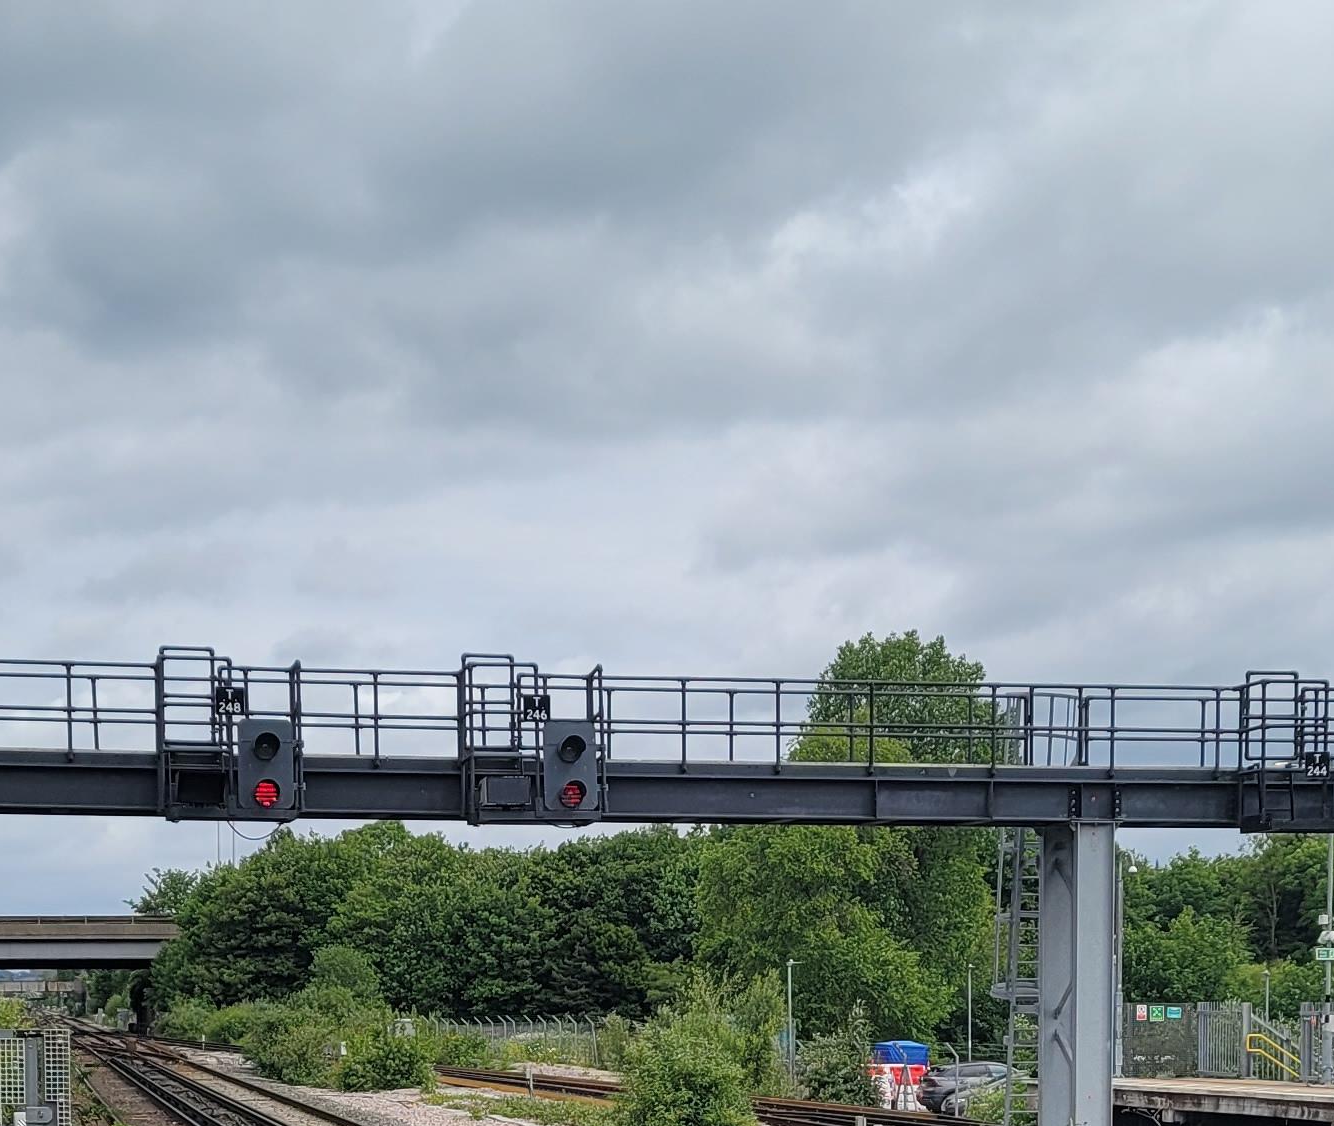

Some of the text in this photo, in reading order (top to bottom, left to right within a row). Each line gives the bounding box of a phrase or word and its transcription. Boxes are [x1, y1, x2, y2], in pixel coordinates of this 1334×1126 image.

[225, 688, 234, 700] T
[532, 696, 542, 707] T
[219, 702, 241, 713] 248
[526, 709, 547, 720] 246
[1313, 753, 1322, 764] T
[1307, 765, 1327, 776] 244
